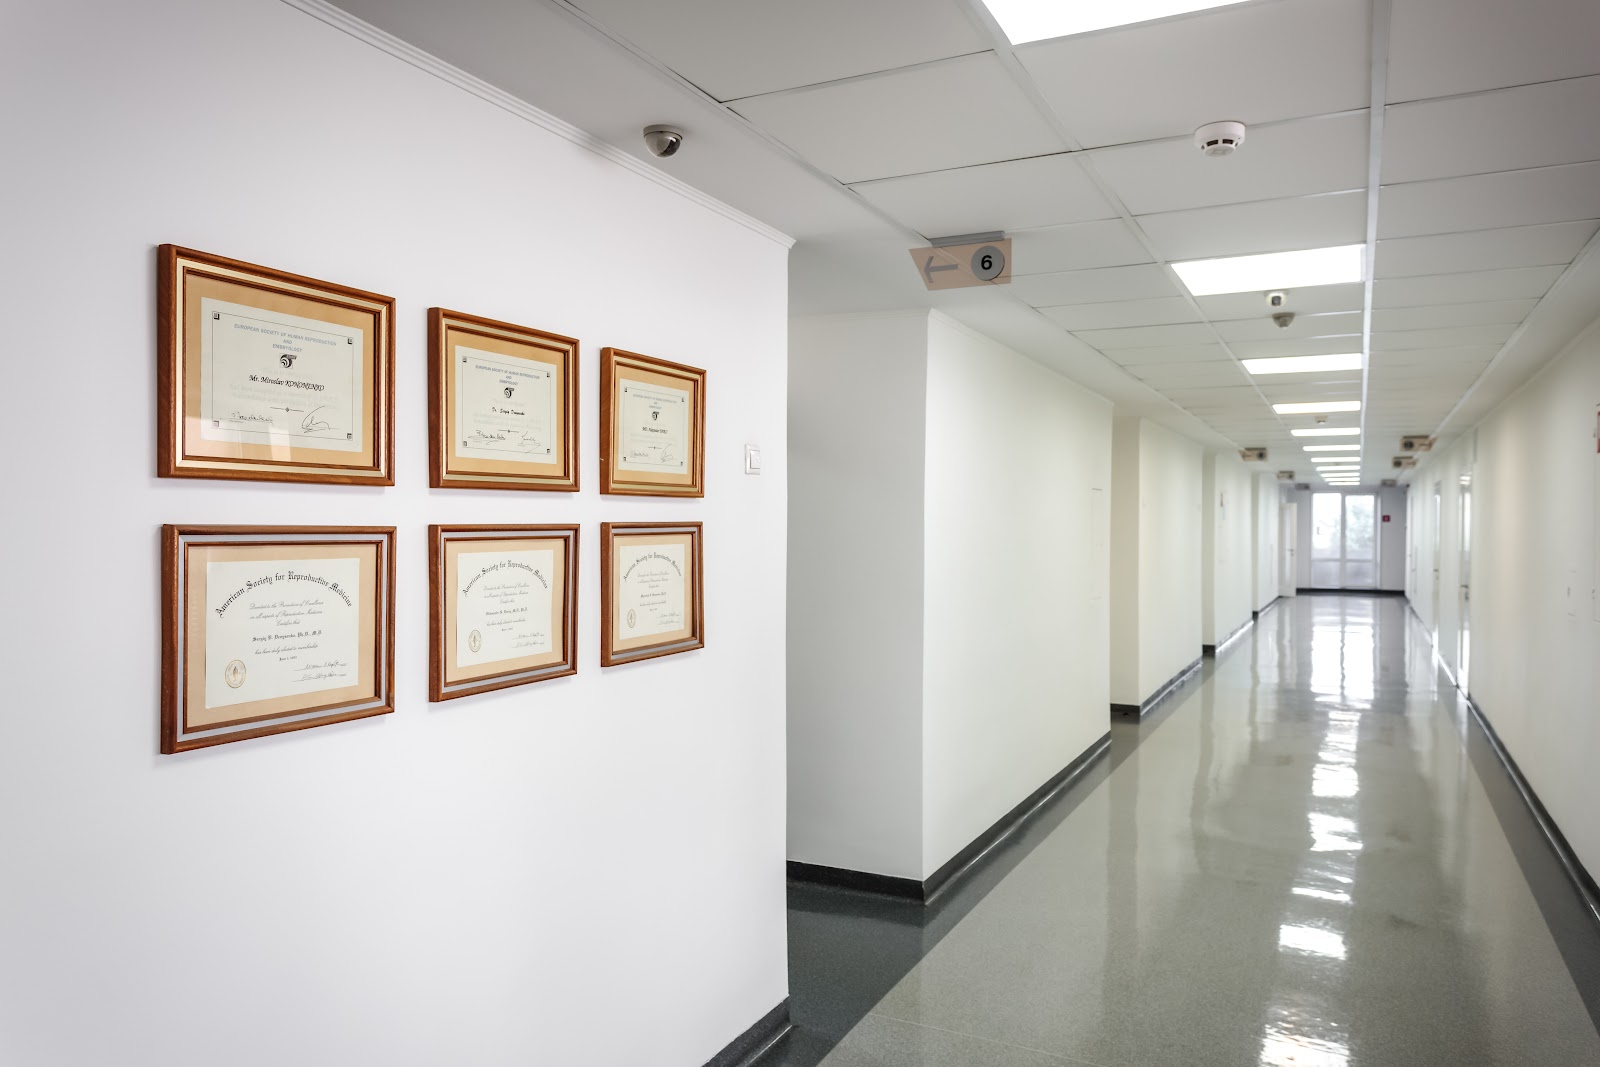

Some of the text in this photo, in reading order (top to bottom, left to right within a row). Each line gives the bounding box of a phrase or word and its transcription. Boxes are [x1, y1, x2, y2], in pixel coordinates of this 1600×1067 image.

[981, 254, 992, 270] 6
[234, 324, 260, 332] EUROPEAN
[304, 336, 336, 346] REPRODUCTION
[463, 573, 481, 597] American
[481, 564, 499, 577] Society
[507, 560, 533, 572] Reproductive
[533, 569, 548, 588] Medicine
[215, 570, 352, 618] American Society for Reproductive Medicine
